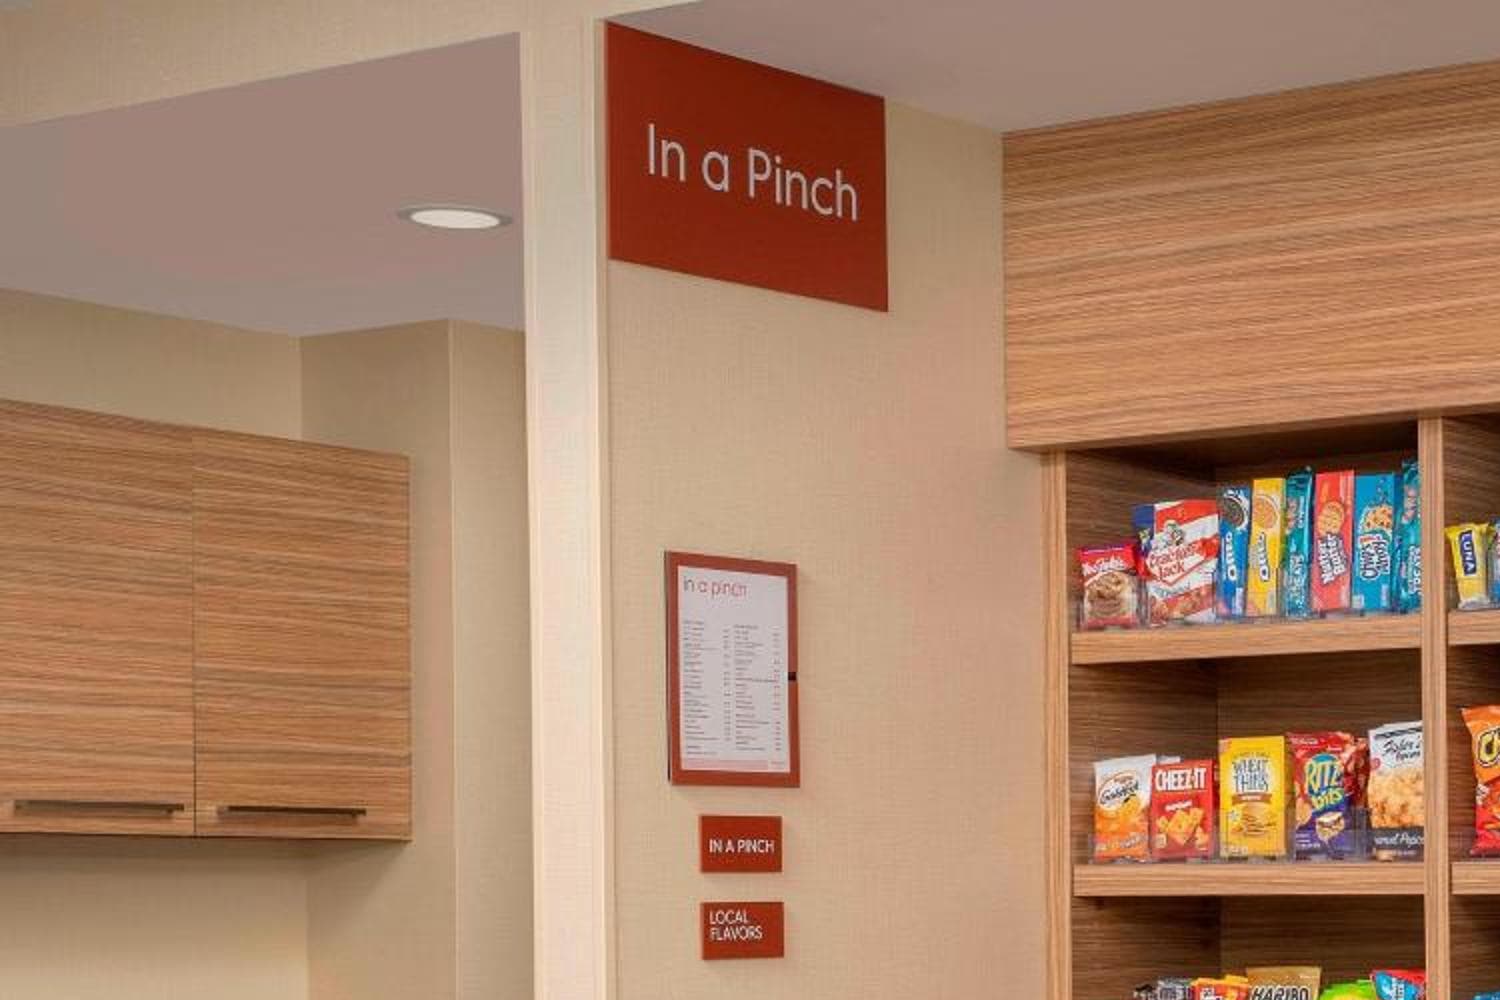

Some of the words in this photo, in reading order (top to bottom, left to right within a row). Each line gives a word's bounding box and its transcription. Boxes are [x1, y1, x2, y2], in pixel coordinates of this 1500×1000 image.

[648, 121, 687, 183] In
[702, 150, 730, 193] a
[748, 146, 859, 222] Pinch
[1460, 532, 1476, 573] LUNA
[709, 839, 723, 854] IN
[725, 839, 735, 853] A
[737, 839, 775, 854] PINCH
[709, 909, 749, 925] LOCAL
[710, 925, 763, 942] FLAVORS
